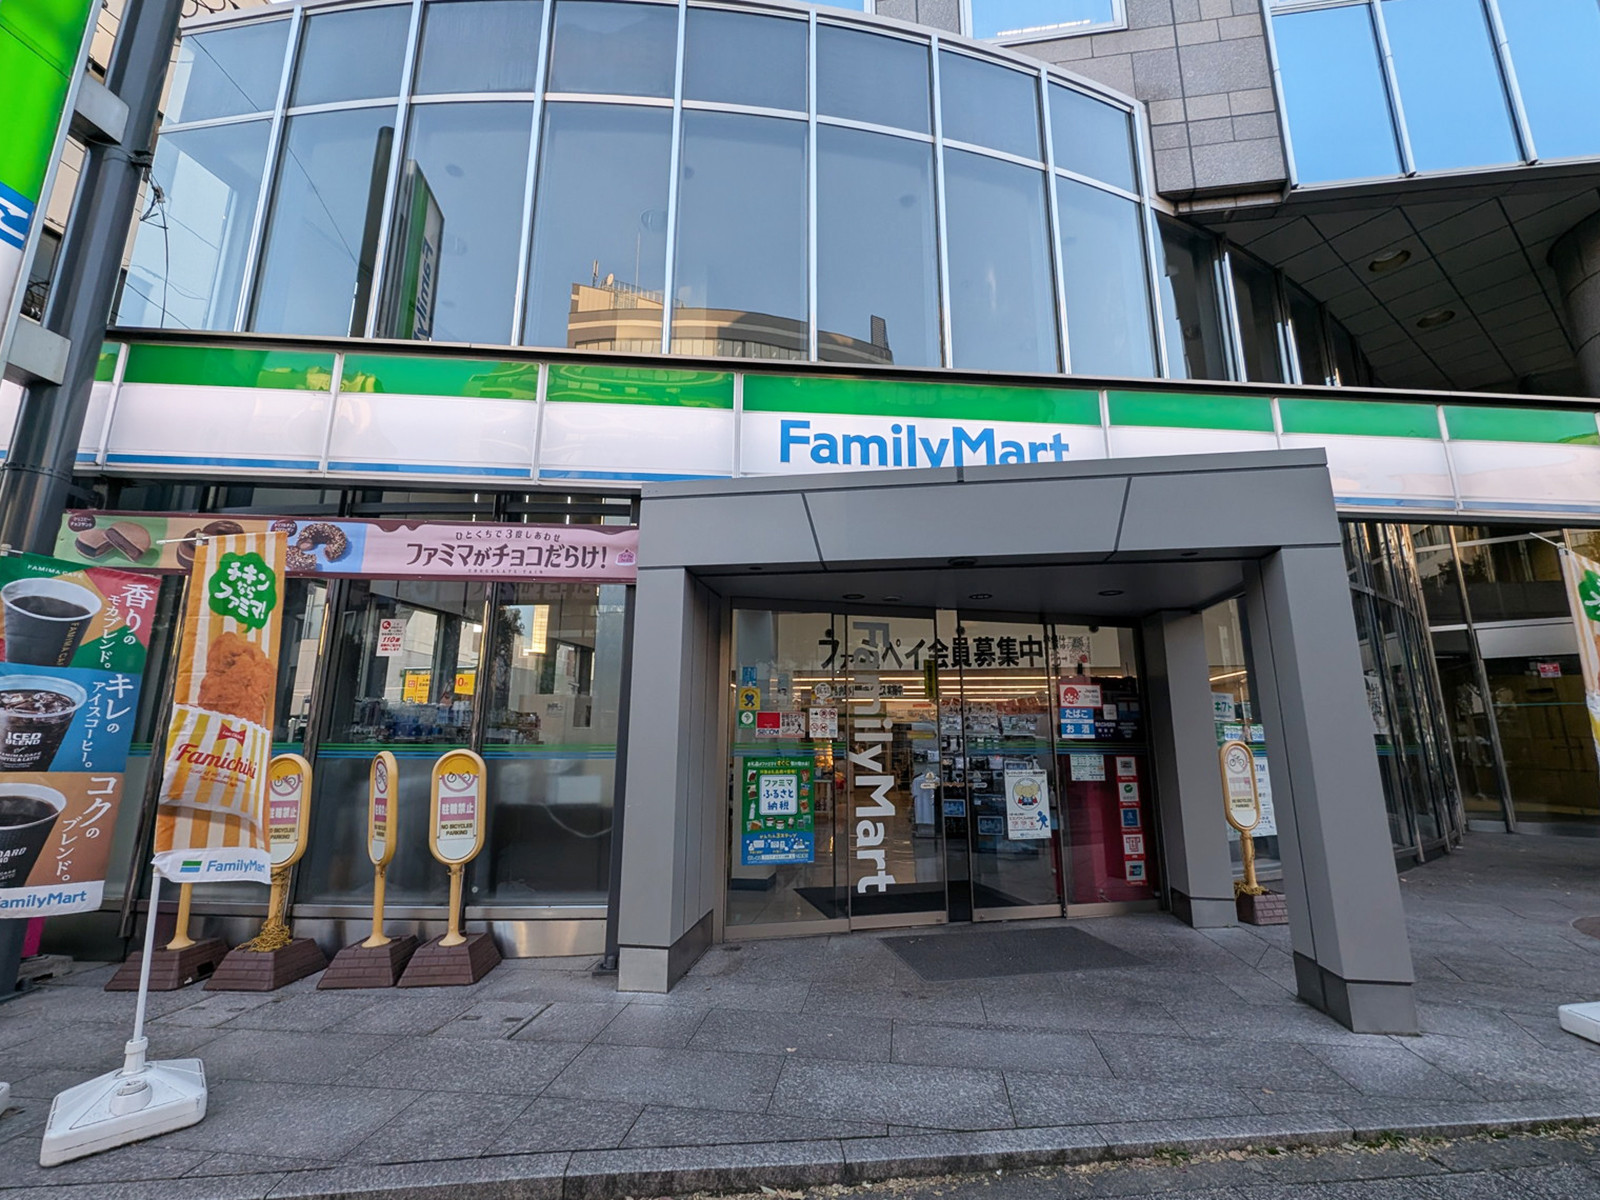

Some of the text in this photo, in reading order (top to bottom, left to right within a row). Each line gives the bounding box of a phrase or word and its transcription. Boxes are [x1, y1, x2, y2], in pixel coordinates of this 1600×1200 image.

[780, 419, 1069, 468] FamilyMart
[456, 529, 561, 542] ひとくちで3度しあわせ
[406, 543, 607, 569] ファミマがチョコだらけ!
[227, 562, 270, 591] チキン
[237, 581, 256, 599] なら
[121, 584, 155, 645] 香りの
[99, 595, 122, 669] モカブレンド。
[105, 674, 134, 734] キレの
[1065, 709, 1089, 719] たばこ
[8, 732, 42, 741] ICED
[82, 681, 106, 768] アイスコーヒー。
[5, 738, 41, 746] BLEND
[175, 743, 258, 779] Famichiki
[849, 622, 896, 893] FamilyMart
[763, 788, 794, 799] ふるさと
[764, 779, 793, 787] ファミマ
[80, 777, 117, 838] コクの
[767, 801, 790, 811] 納税
[56, 816, 83, 881] ブレンド。
[0, 890, 87, 908] amilyMart
